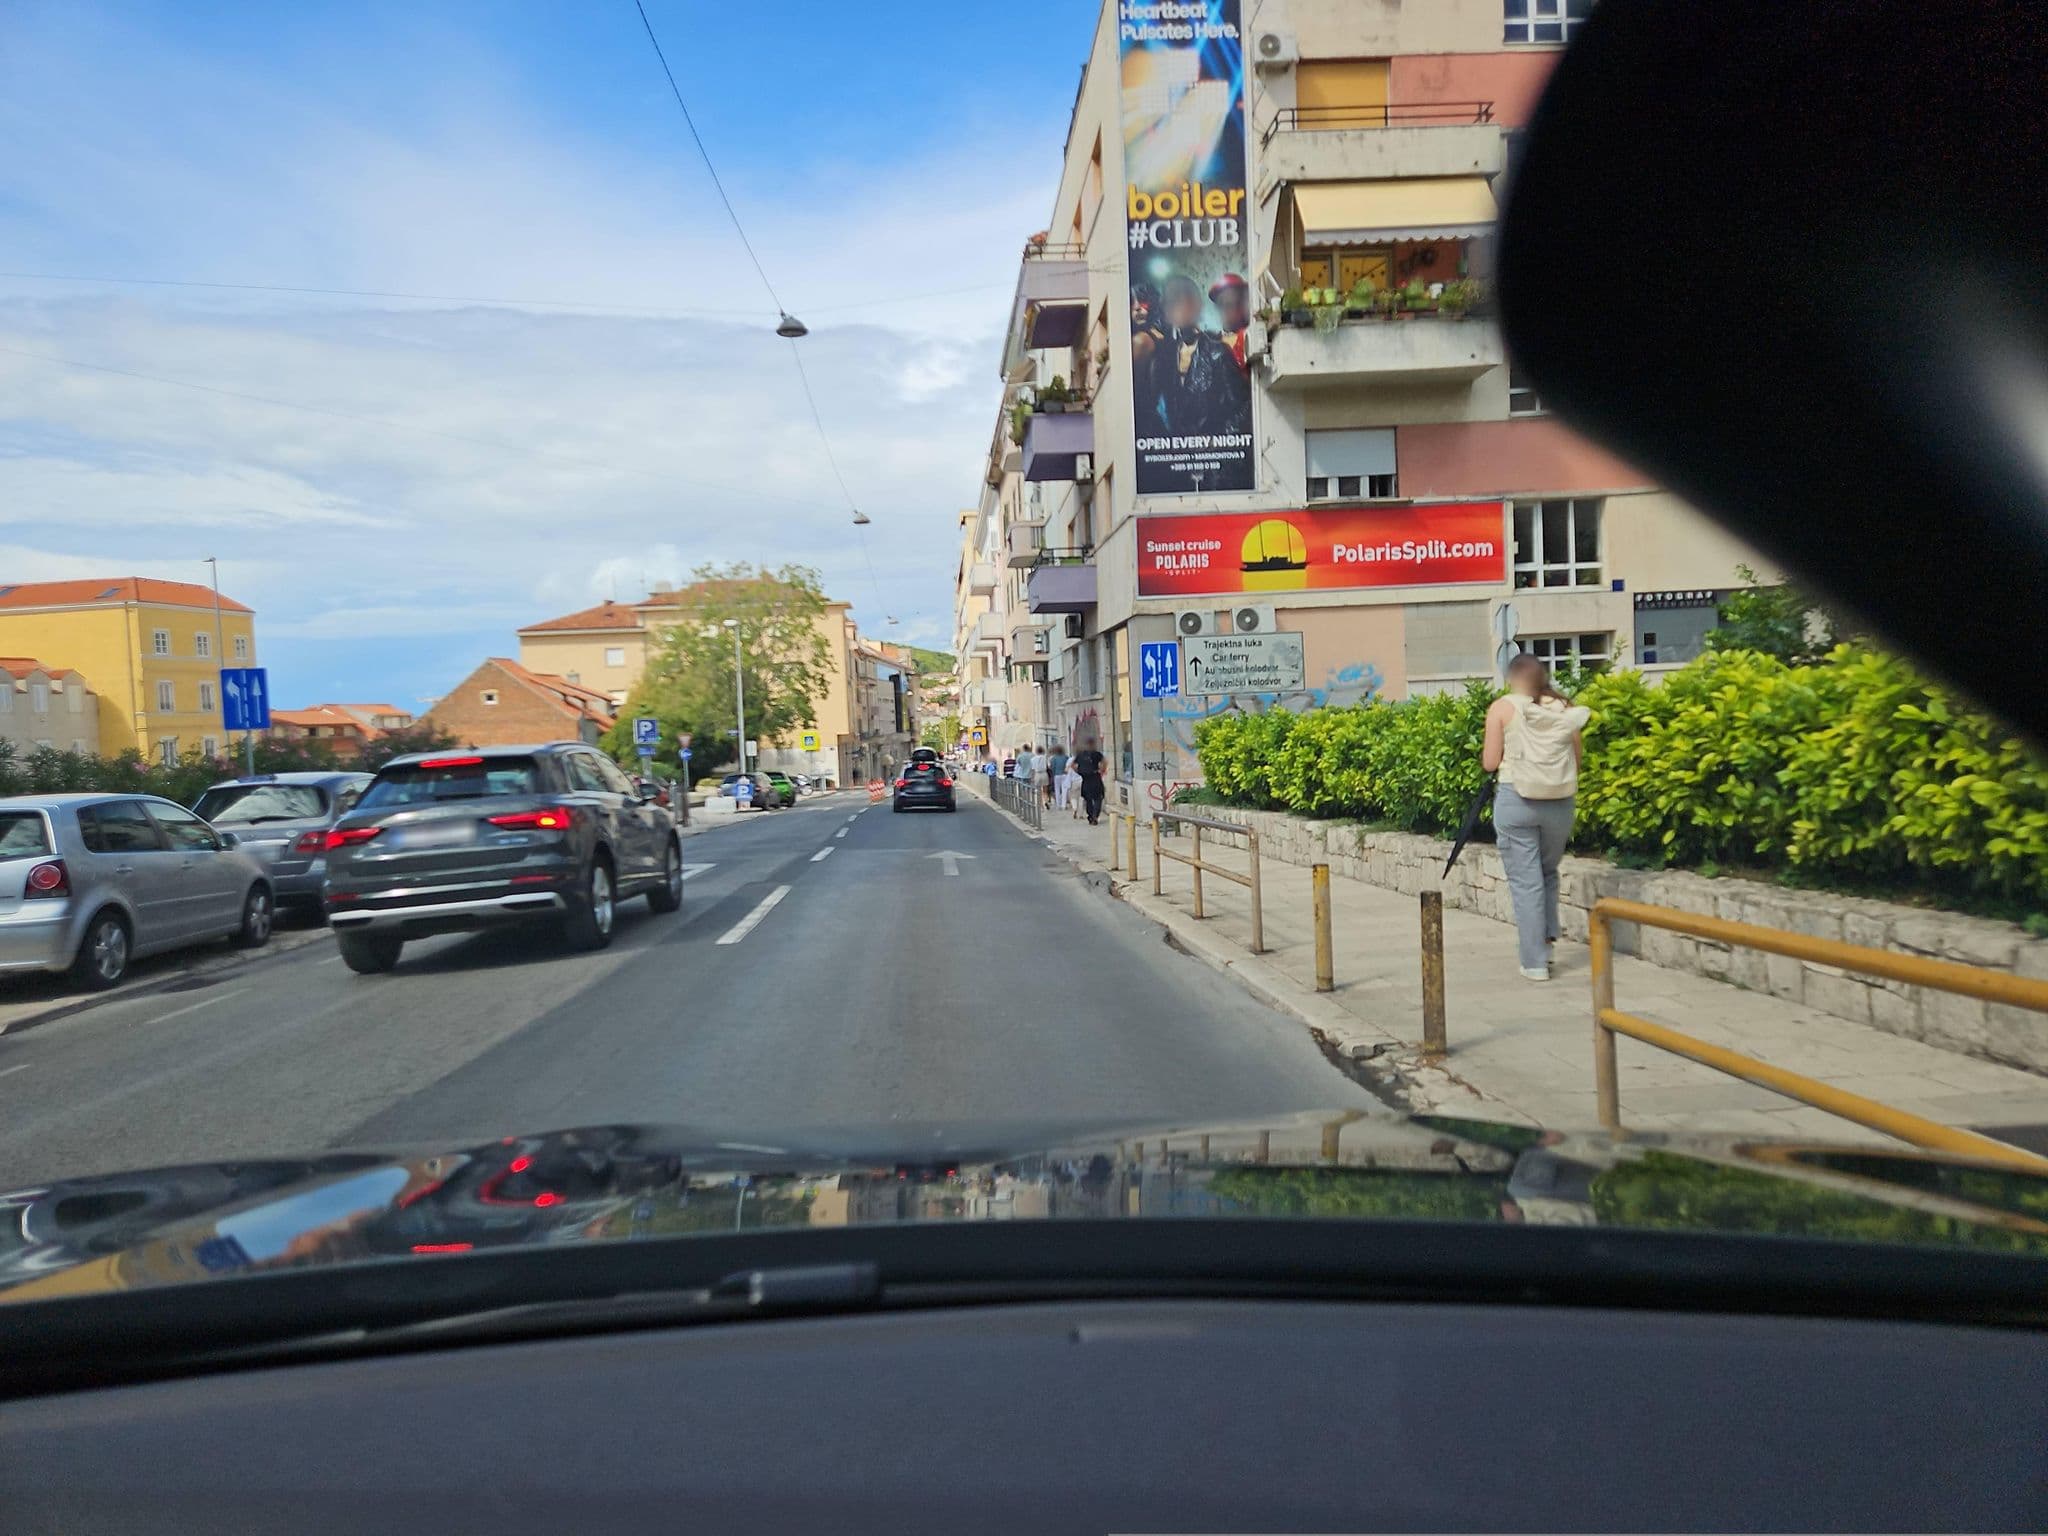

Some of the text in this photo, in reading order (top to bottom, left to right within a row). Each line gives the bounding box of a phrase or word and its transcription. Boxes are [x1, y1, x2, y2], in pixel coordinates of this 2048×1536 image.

[1120, 1, 1208, 20] Heartbeat
[1120, 22, 1240, 40] Pulsates Here.
[1128, 182, 1244, 220] boiler
[1129, 217, 1240, 249] #CLUB
[1136, 434, 1252, 450] OPEN EVERY NIGHT
[1146, 539, 1222, 552] Sunset cruise
[1332, 540, 1494, 565] PolarisSplit.com
[1156, 553, 1209, 570] POLARIS
[1635, 591, 1712, 602] FOTOGRAF
[1203, 639, 1263, 650] Trajektna luka
[1212, 653, 1250, 662] Car ferry
[639, 721, 653, 735] P
